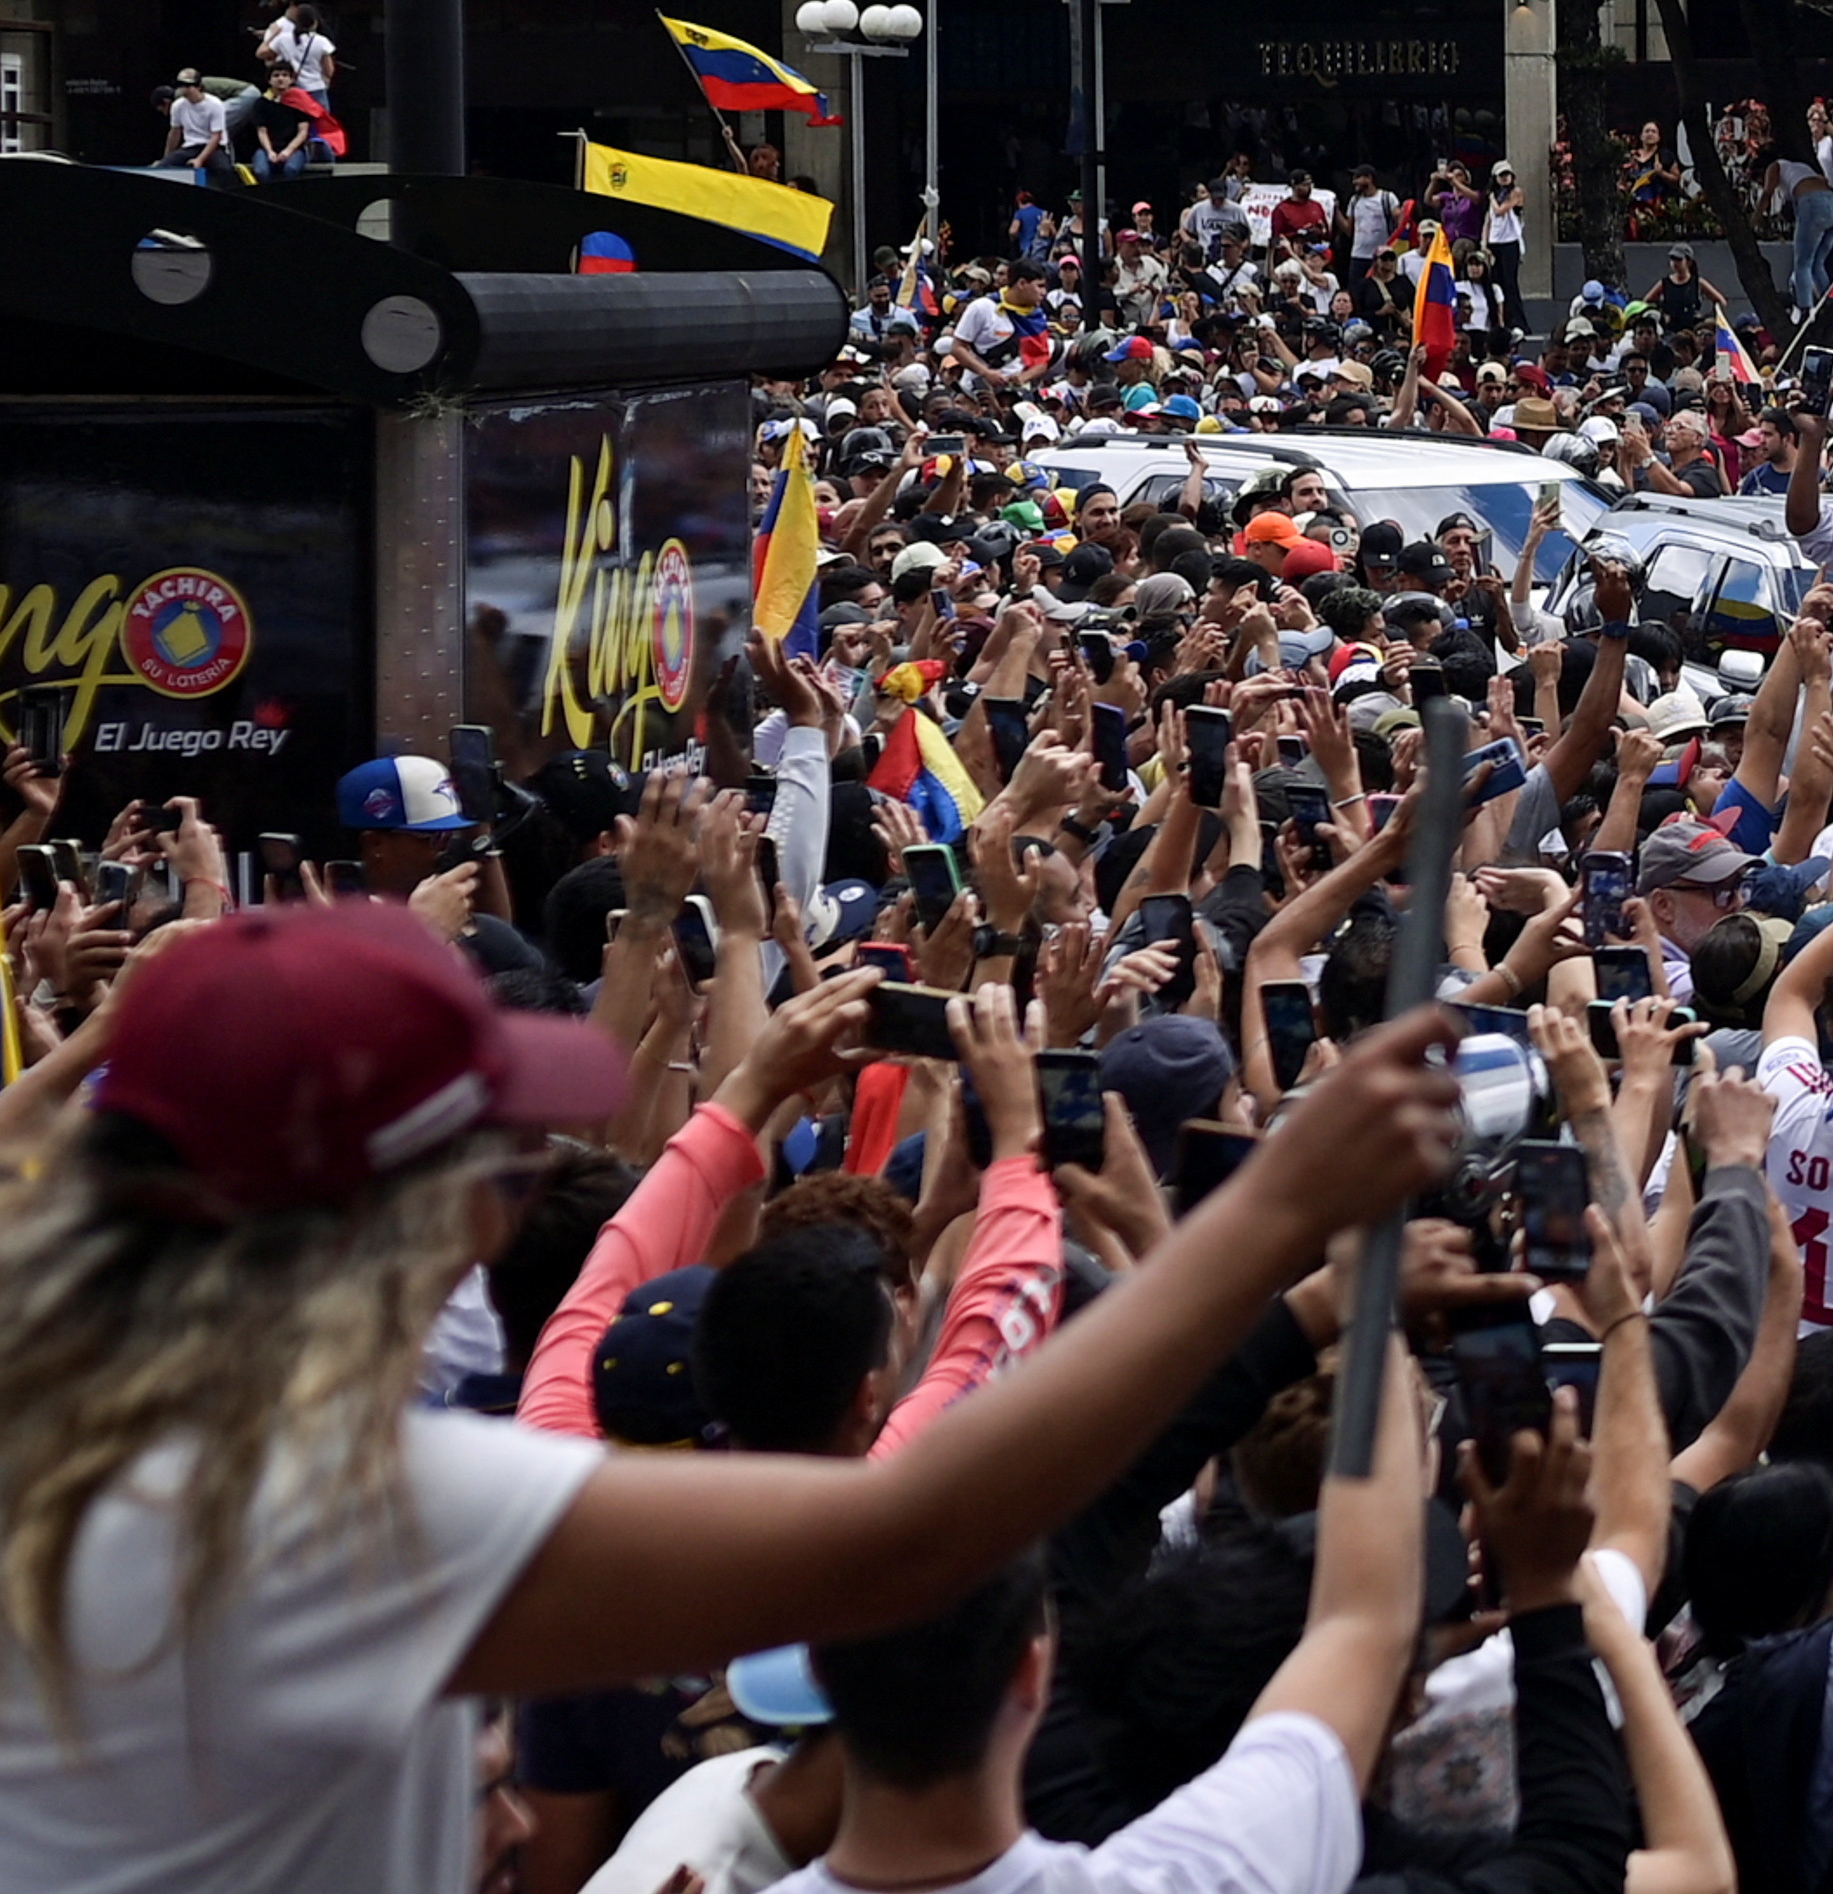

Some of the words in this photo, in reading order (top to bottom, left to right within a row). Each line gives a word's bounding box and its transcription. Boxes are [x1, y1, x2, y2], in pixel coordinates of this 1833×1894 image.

[1259, 41, 1460, 87] TEQUILIBRIO
[142, 658, 162, 679] SU
[95, 723, 123, 751] El
[129, 723, 221, 757] Juego
[228, 721, 289, 755] Rey
